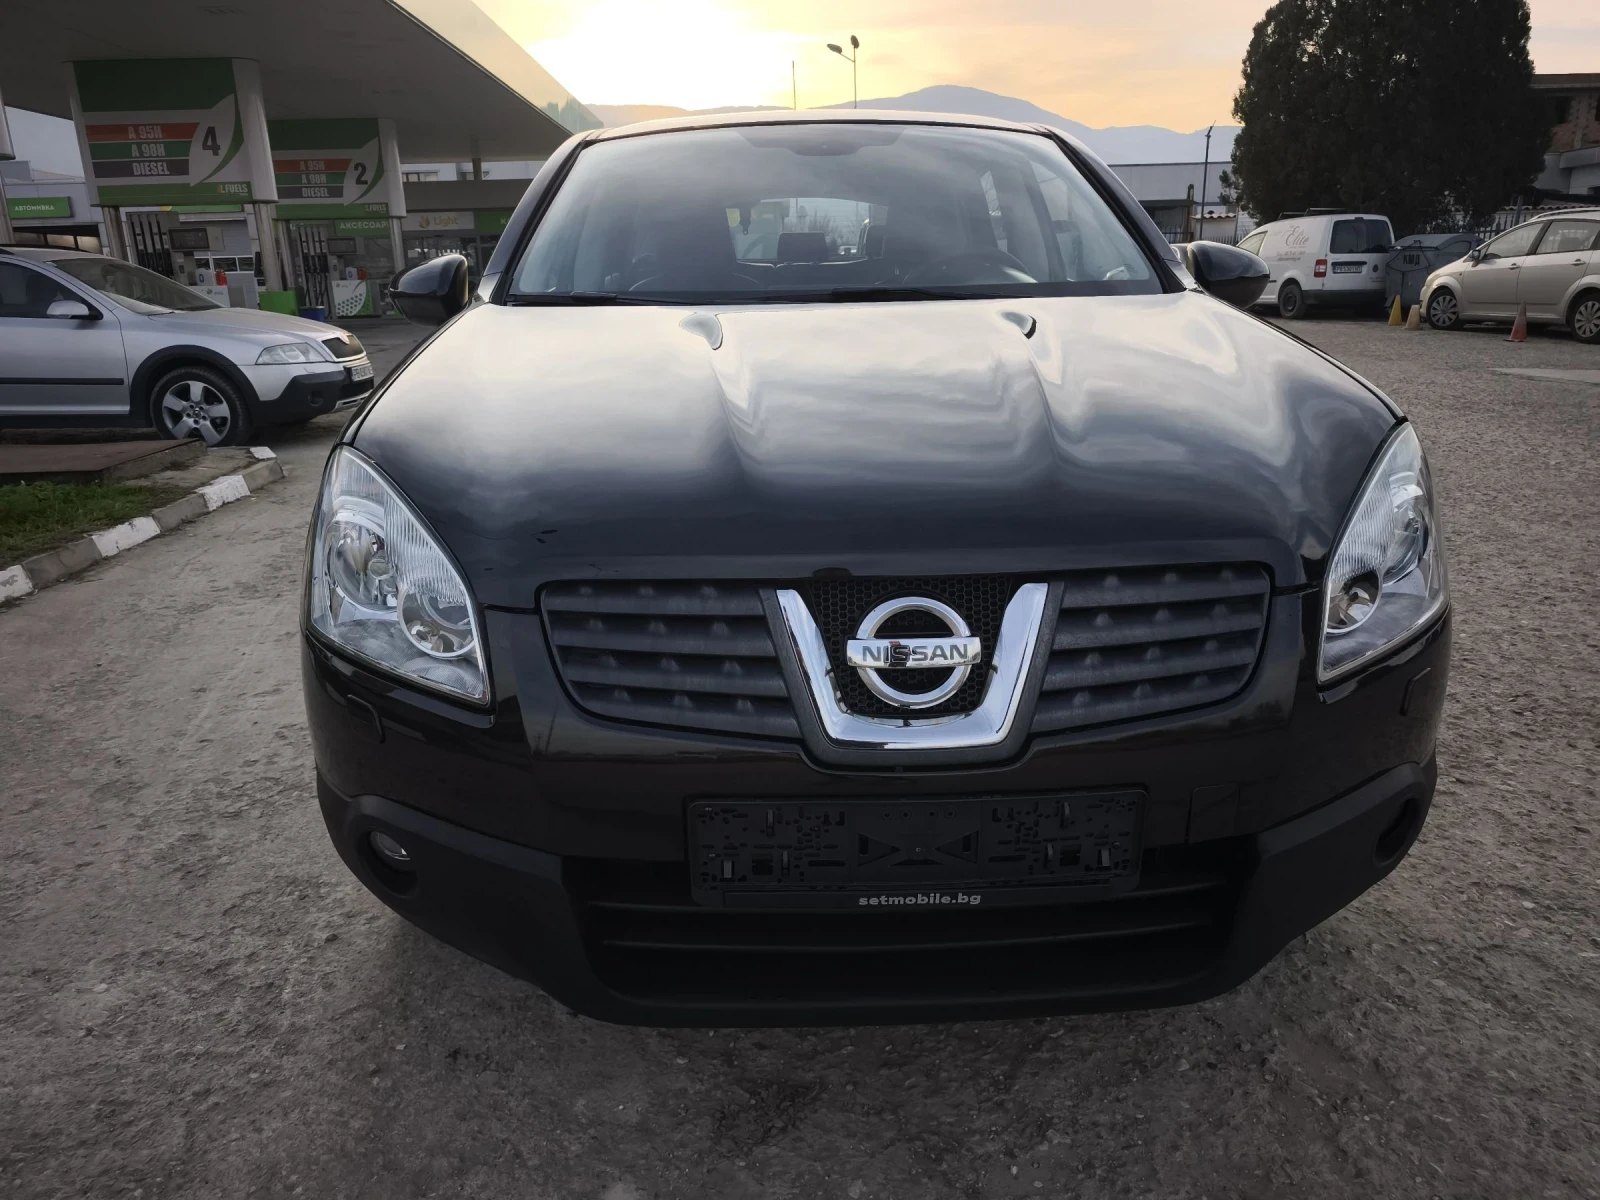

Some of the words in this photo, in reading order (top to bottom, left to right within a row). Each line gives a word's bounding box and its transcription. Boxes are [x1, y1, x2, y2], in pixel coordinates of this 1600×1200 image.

[201, 126, 220, 156] 4
[133, 162, 170, 176] DIESEL
[353, 162, 368, 185] 2
[301, 187, 330, 198] DIESEL
[861, 642, 968, 663] NISSAN
[858, 892, 982, 907] setmobile.bg
